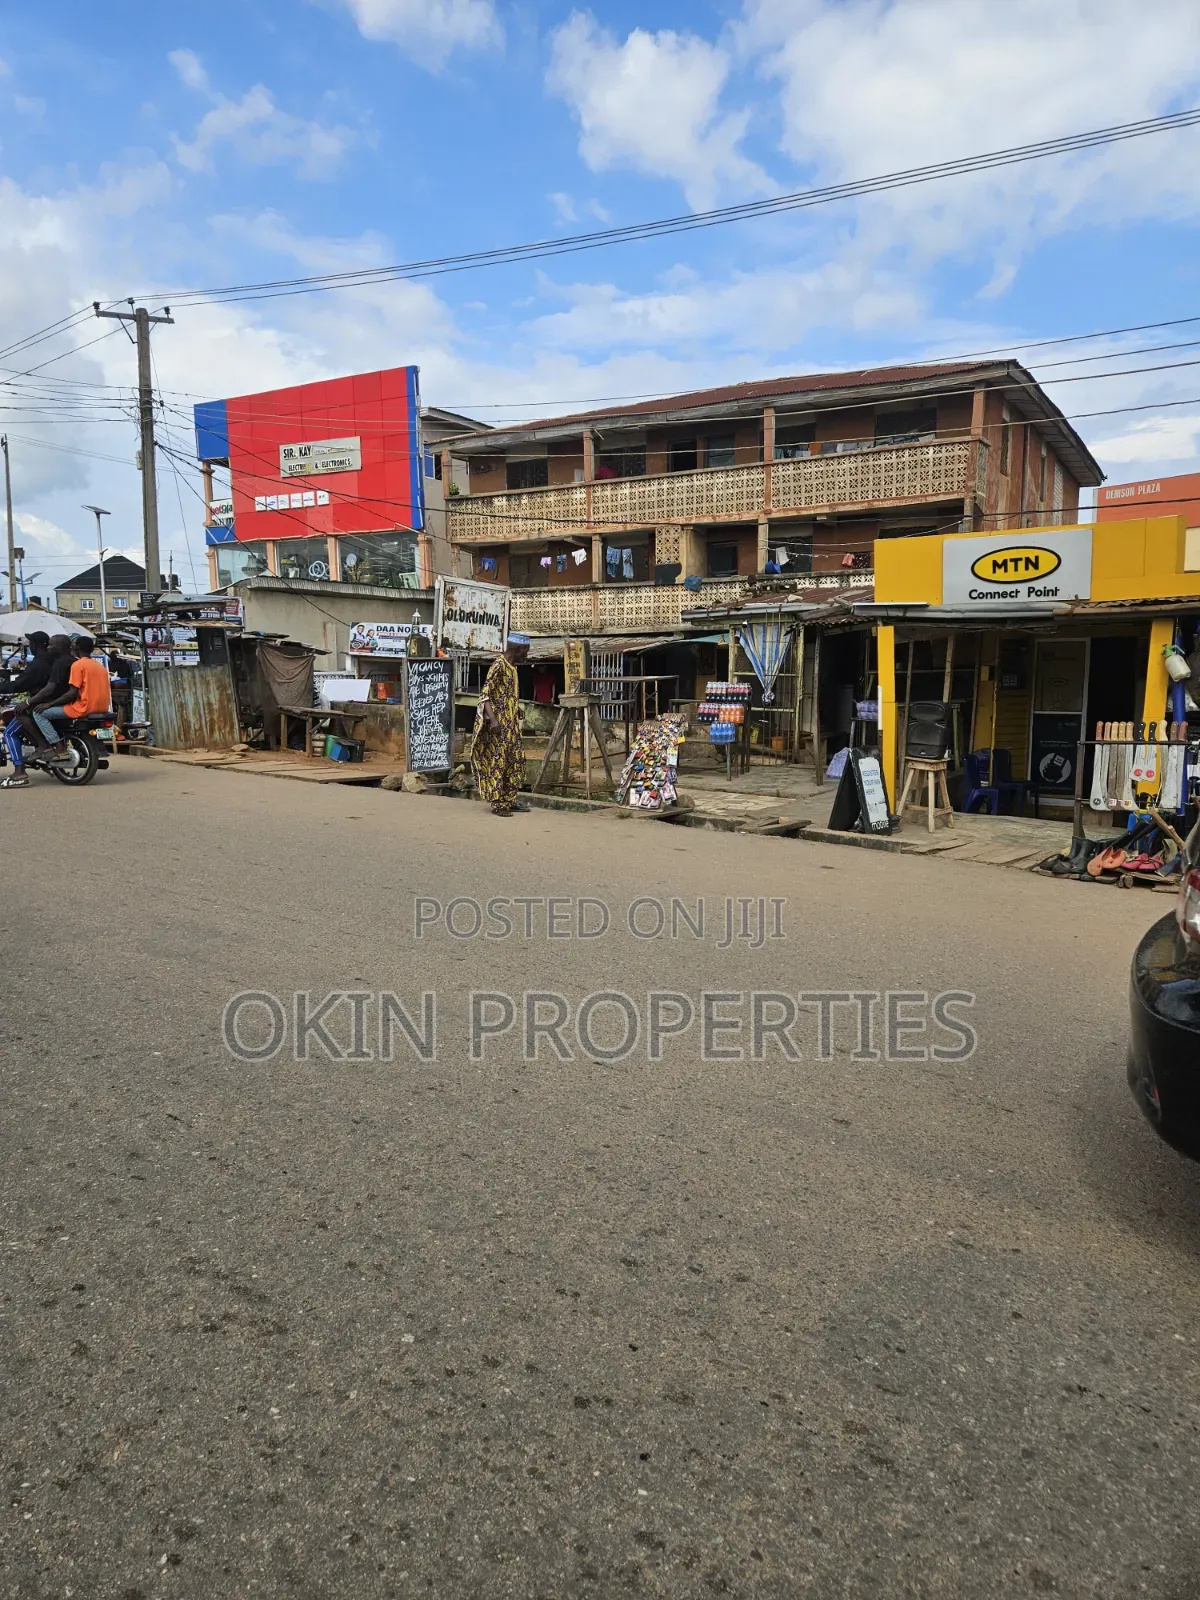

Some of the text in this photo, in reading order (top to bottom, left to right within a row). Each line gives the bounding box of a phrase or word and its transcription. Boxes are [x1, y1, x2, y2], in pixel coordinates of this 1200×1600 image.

[299, 445, 312, 457] KAY
[321, 458, 351, 468] ELECTRONICS
[1137, 482, 1161, 495] PLAZA
[992, 555, 1040, 574] MTN
[968, 586, 1060, 600] Connect Point
